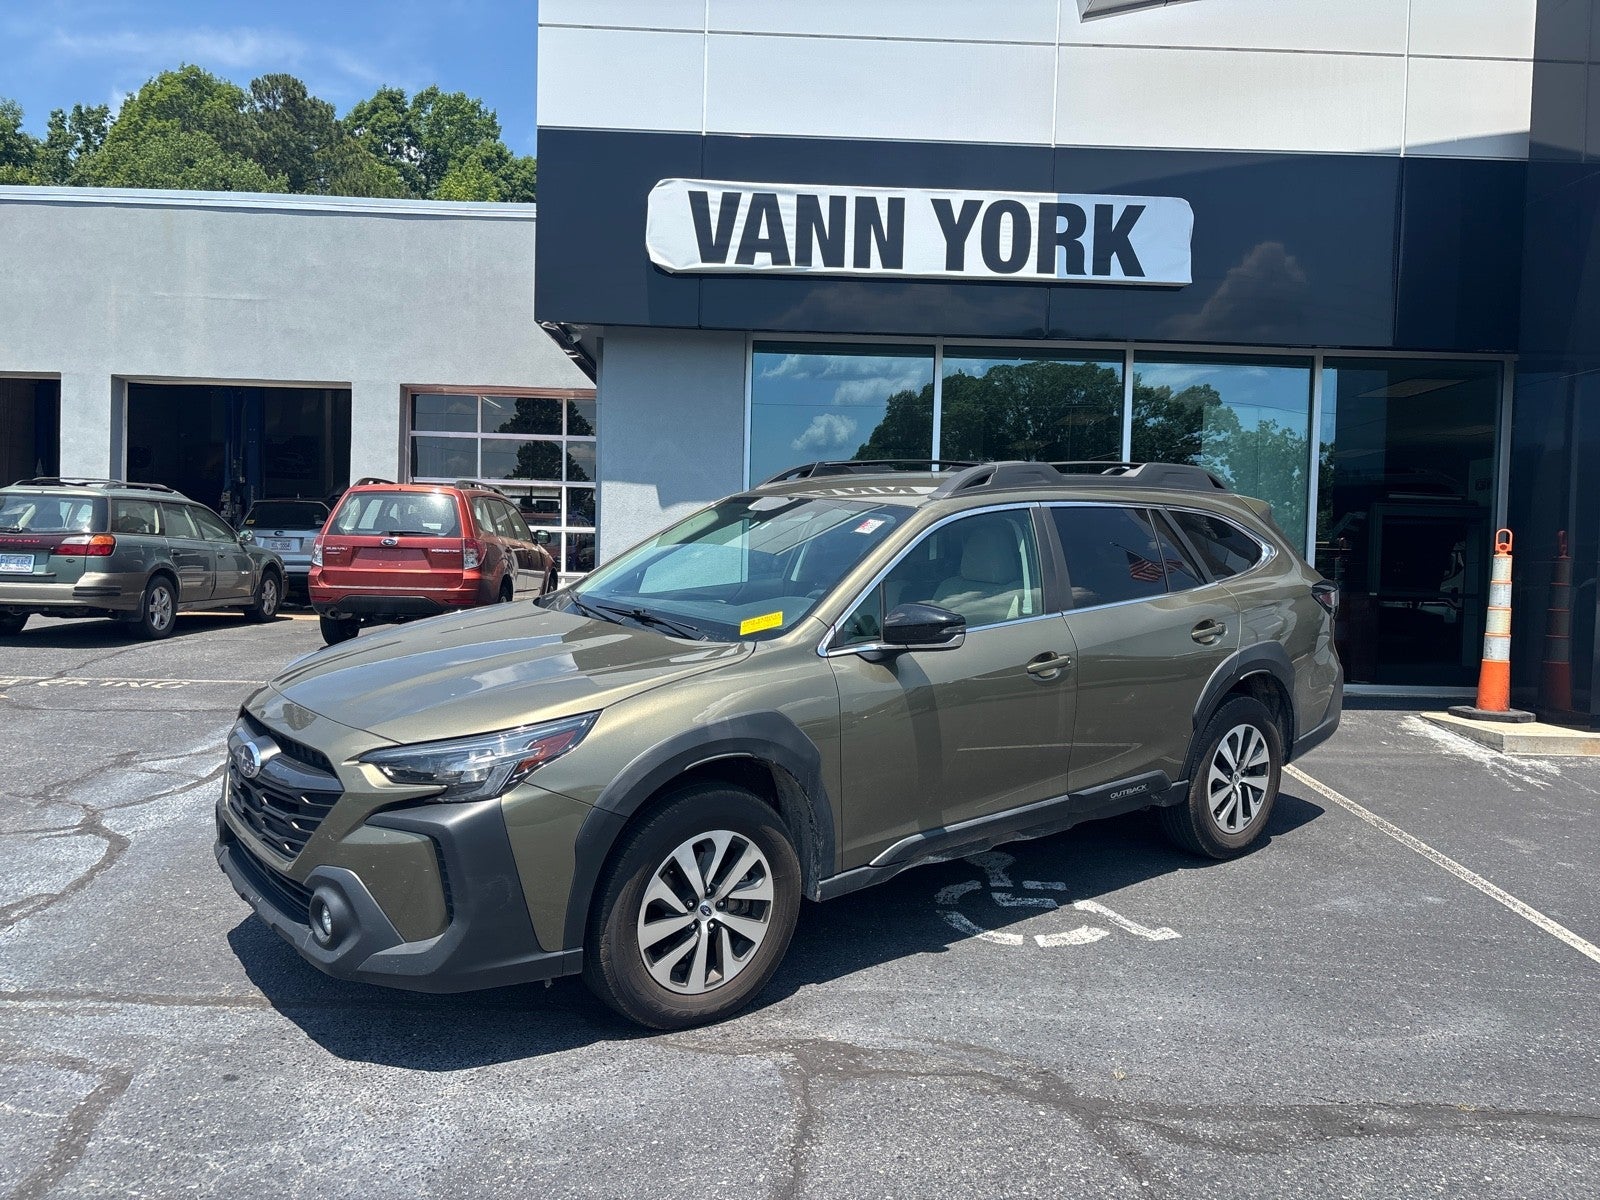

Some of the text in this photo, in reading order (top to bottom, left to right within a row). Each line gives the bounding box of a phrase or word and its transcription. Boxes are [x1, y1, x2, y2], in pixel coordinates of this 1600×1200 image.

[688, 191, 1146, 277] VANN YORK
[1110, 783, 1147, 799] OUTBACK
